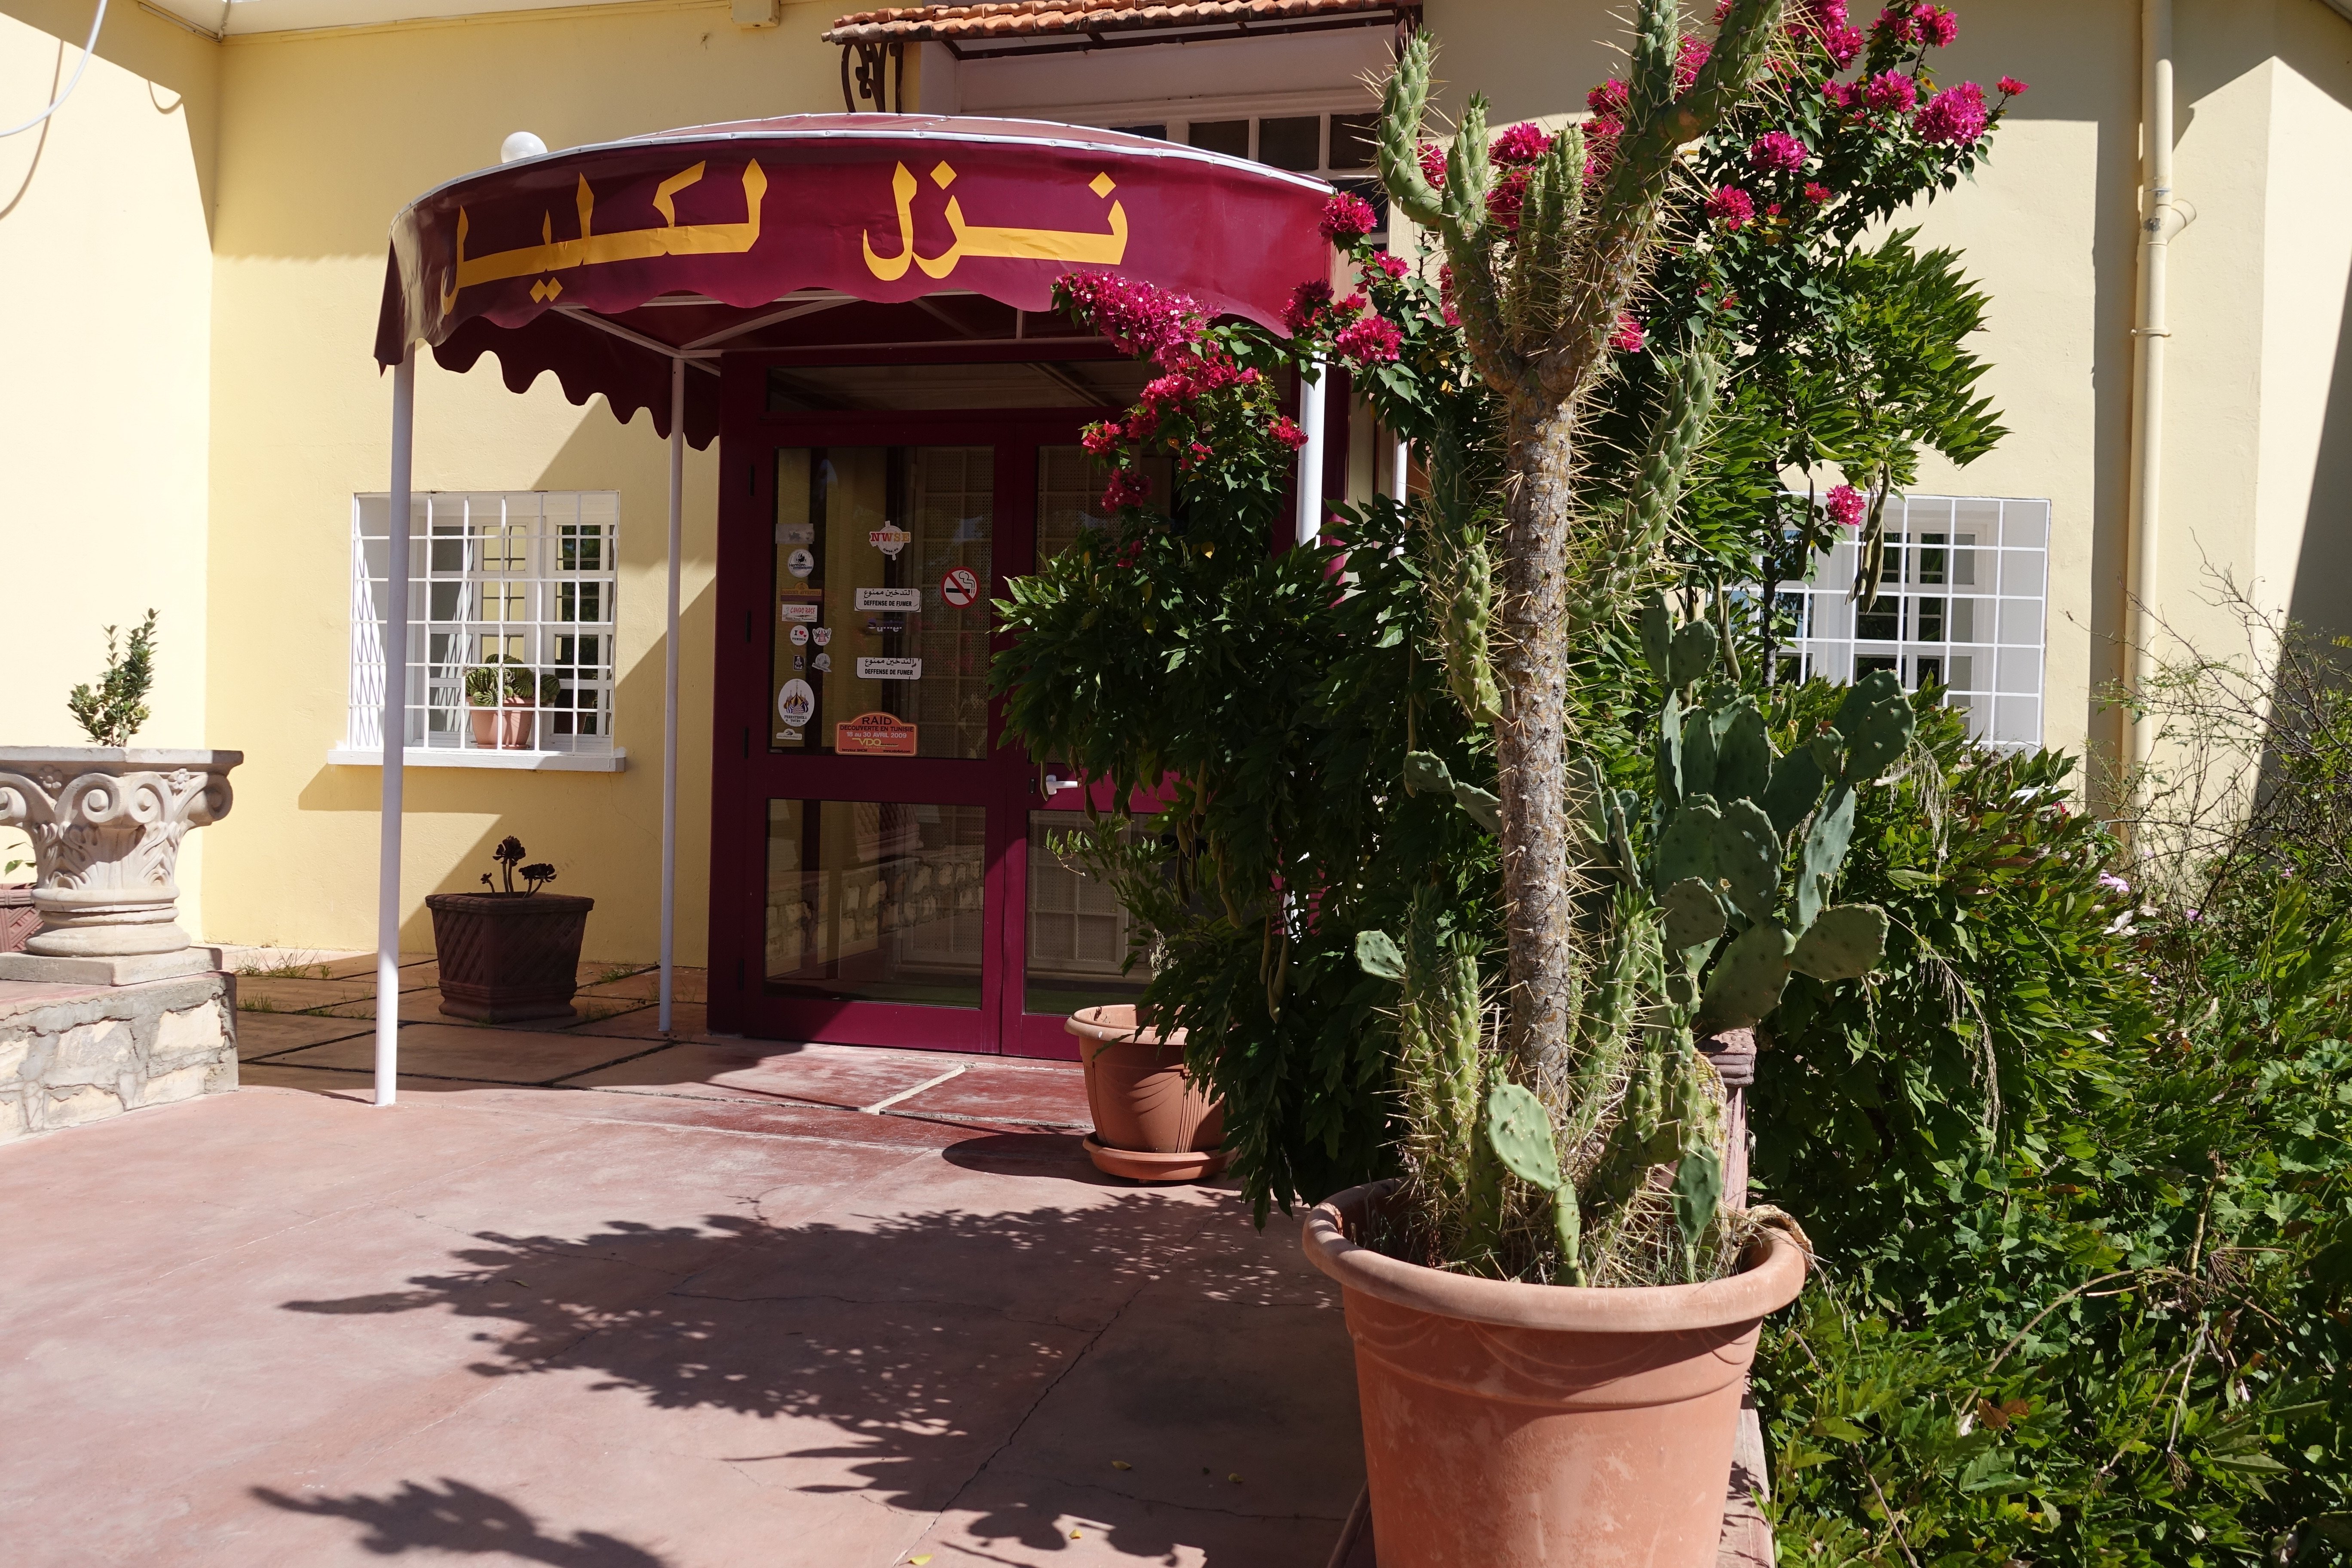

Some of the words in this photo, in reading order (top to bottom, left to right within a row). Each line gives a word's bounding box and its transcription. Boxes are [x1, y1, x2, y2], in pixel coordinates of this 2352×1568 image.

[863, 160, 1128, 281] نزل
[870, 533, 910, 542] NWSE
[864, 589, 884, 598] ممنوع
[865, 658, 885, 667] ممنوع
[862, 716, 892, 725] RAID
